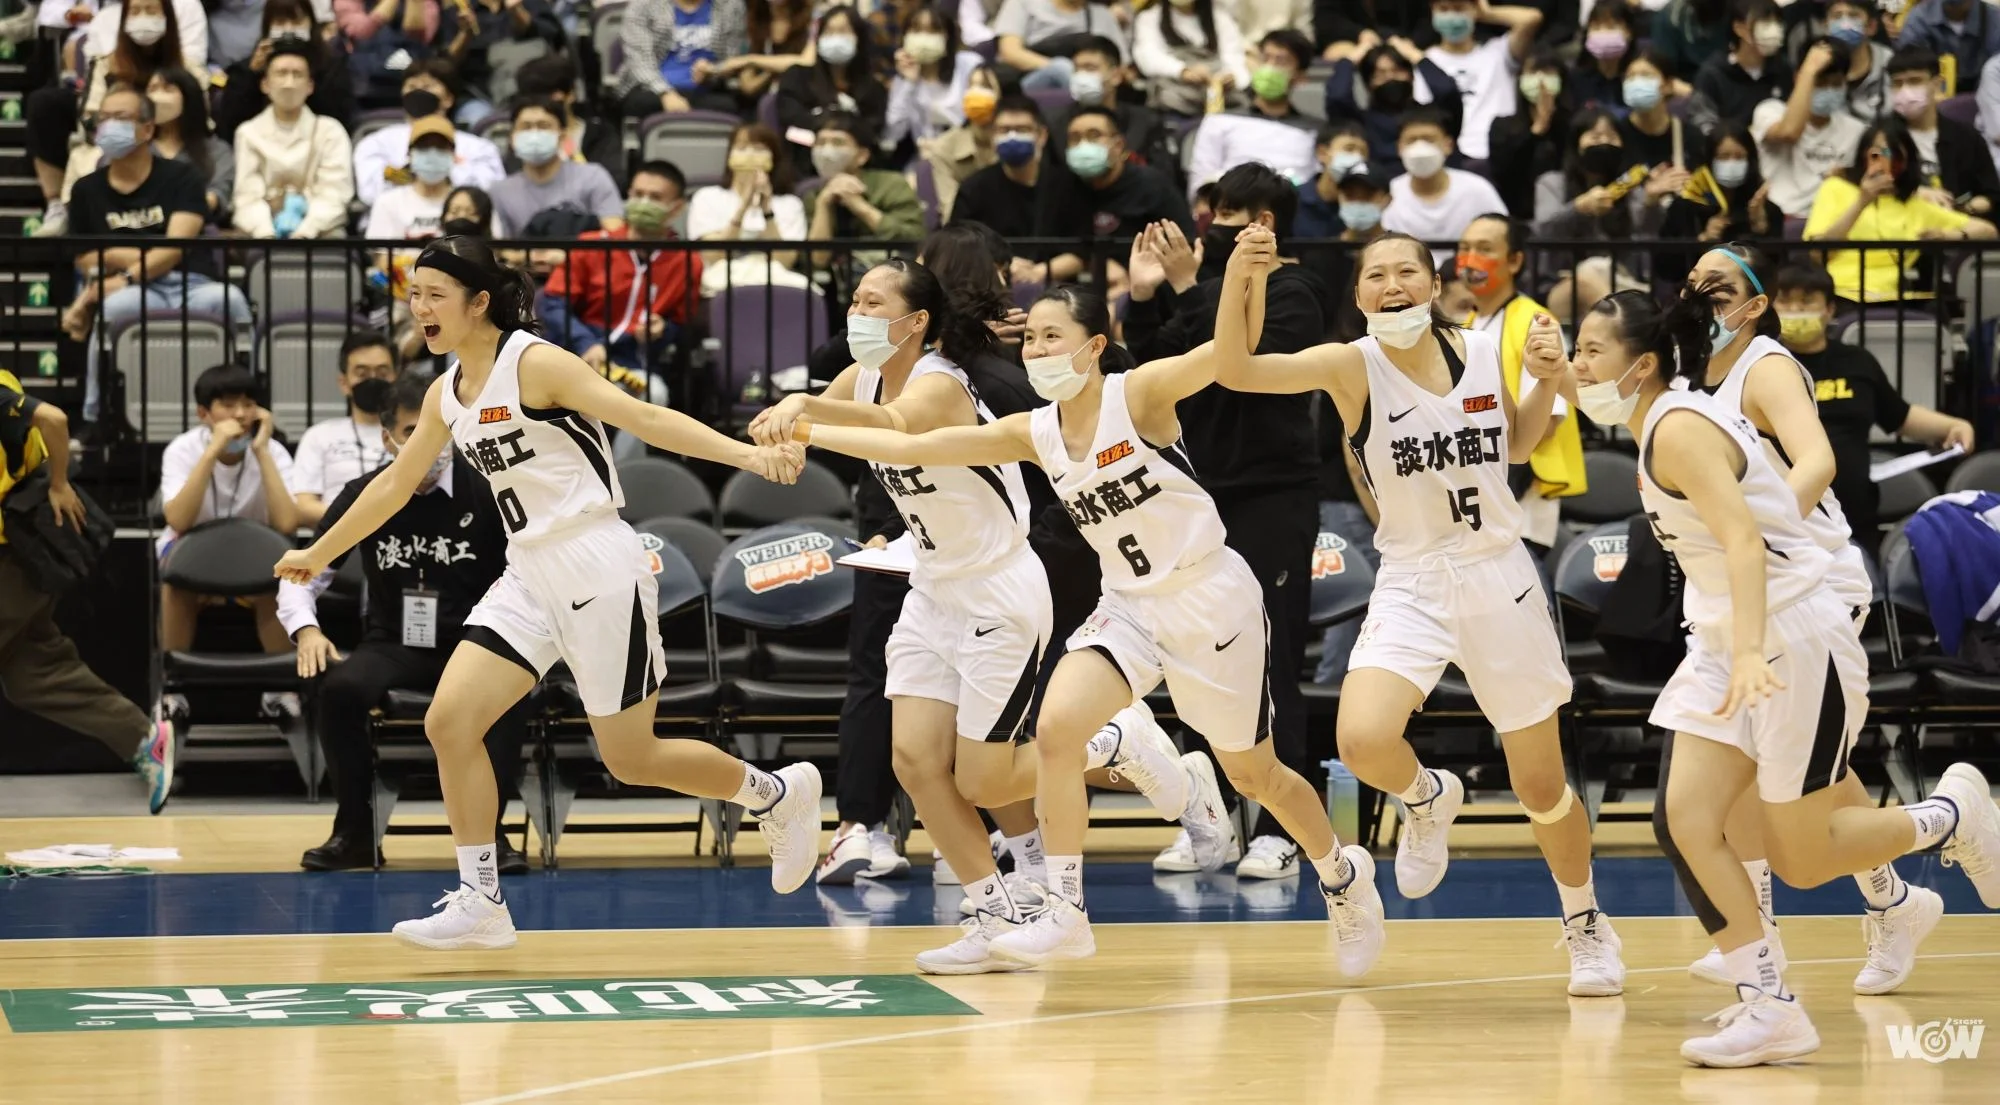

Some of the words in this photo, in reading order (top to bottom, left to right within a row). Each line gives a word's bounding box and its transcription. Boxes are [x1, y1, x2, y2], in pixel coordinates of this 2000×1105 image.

[479, 406, 511, 424] HBL
[1463, 394, 1497, 413] HBL
[464, 428, 536, 476] 水商工
[1096, 440, 1135, 469] HBL
[1390, 427, 1502, 477] 淡水商工
[872, 463, 937, 497] 水商工
[1447, 487, 1482, 531] 15
[902, 512, 936, 550] 3
[376, 534, 477, 571] 淡水商工
[741, 536, 823, 564] WEIDER
[1118, 534, 1151, 577] 6
[68, 978, 883, 1021] 純喫茶
